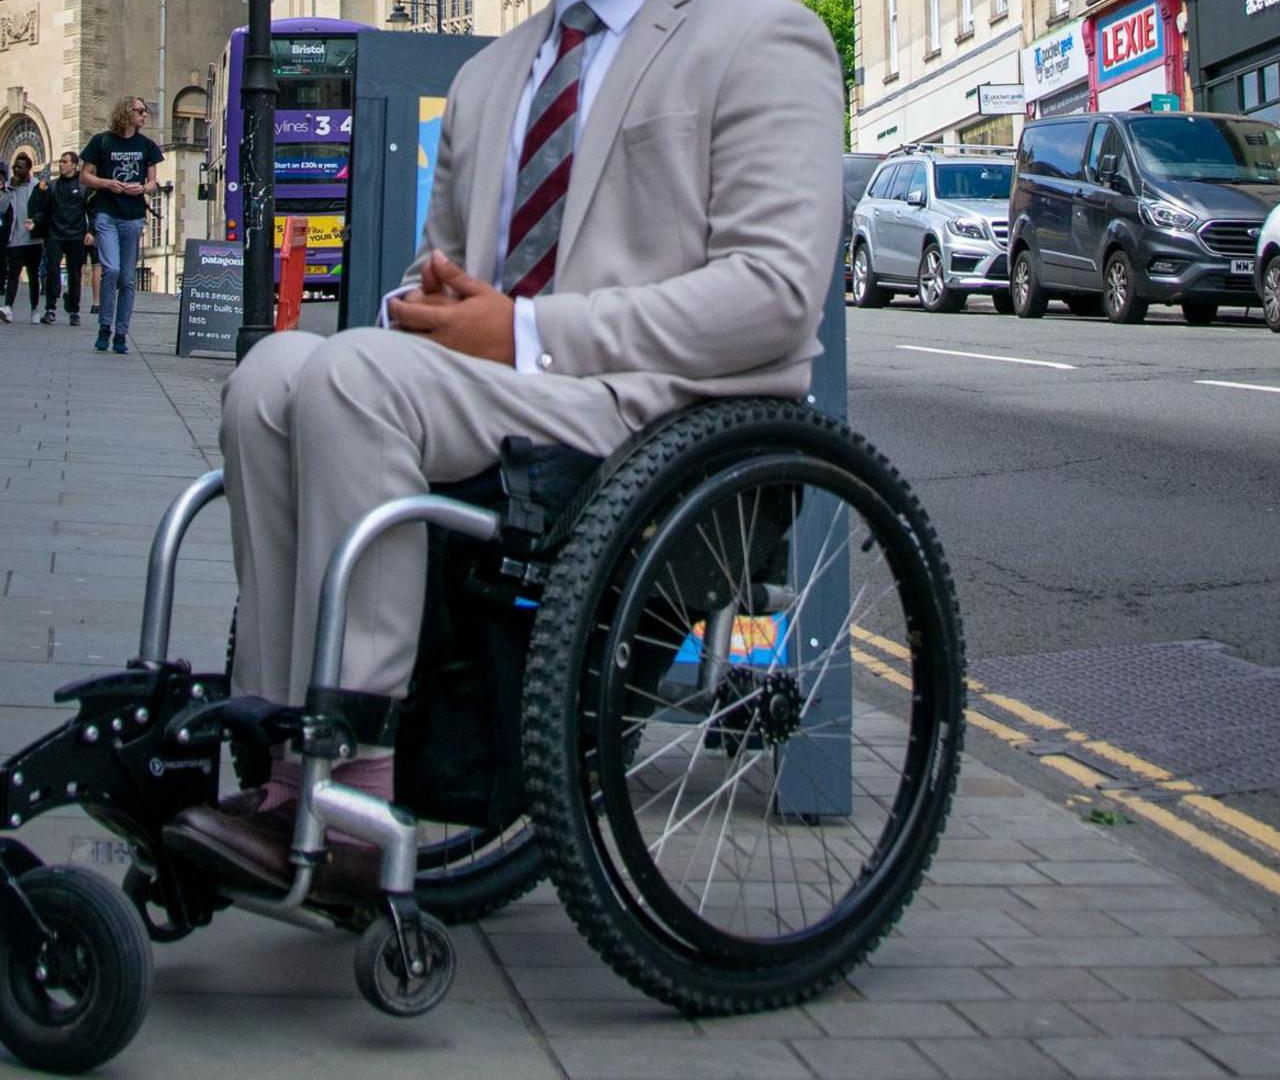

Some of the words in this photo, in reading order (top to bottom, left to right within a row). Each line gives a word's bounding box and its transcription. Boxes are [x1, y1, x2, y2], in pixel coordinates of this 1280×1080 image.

[1102, 7, 1156, 68] LEXIE
[291, 44, 325, 54] Bristol
[315, 116, 331, 135] 3
[340, 115, 352, 135] 4
[310, 234, 331, 242] YOUR
[190, 288, 210, 299] Past
[211, 291, 240, 301] season
[189, 302, 212, 312] gear
[213, 303, 233, 313] built
[188, 315, 207, 325] last
